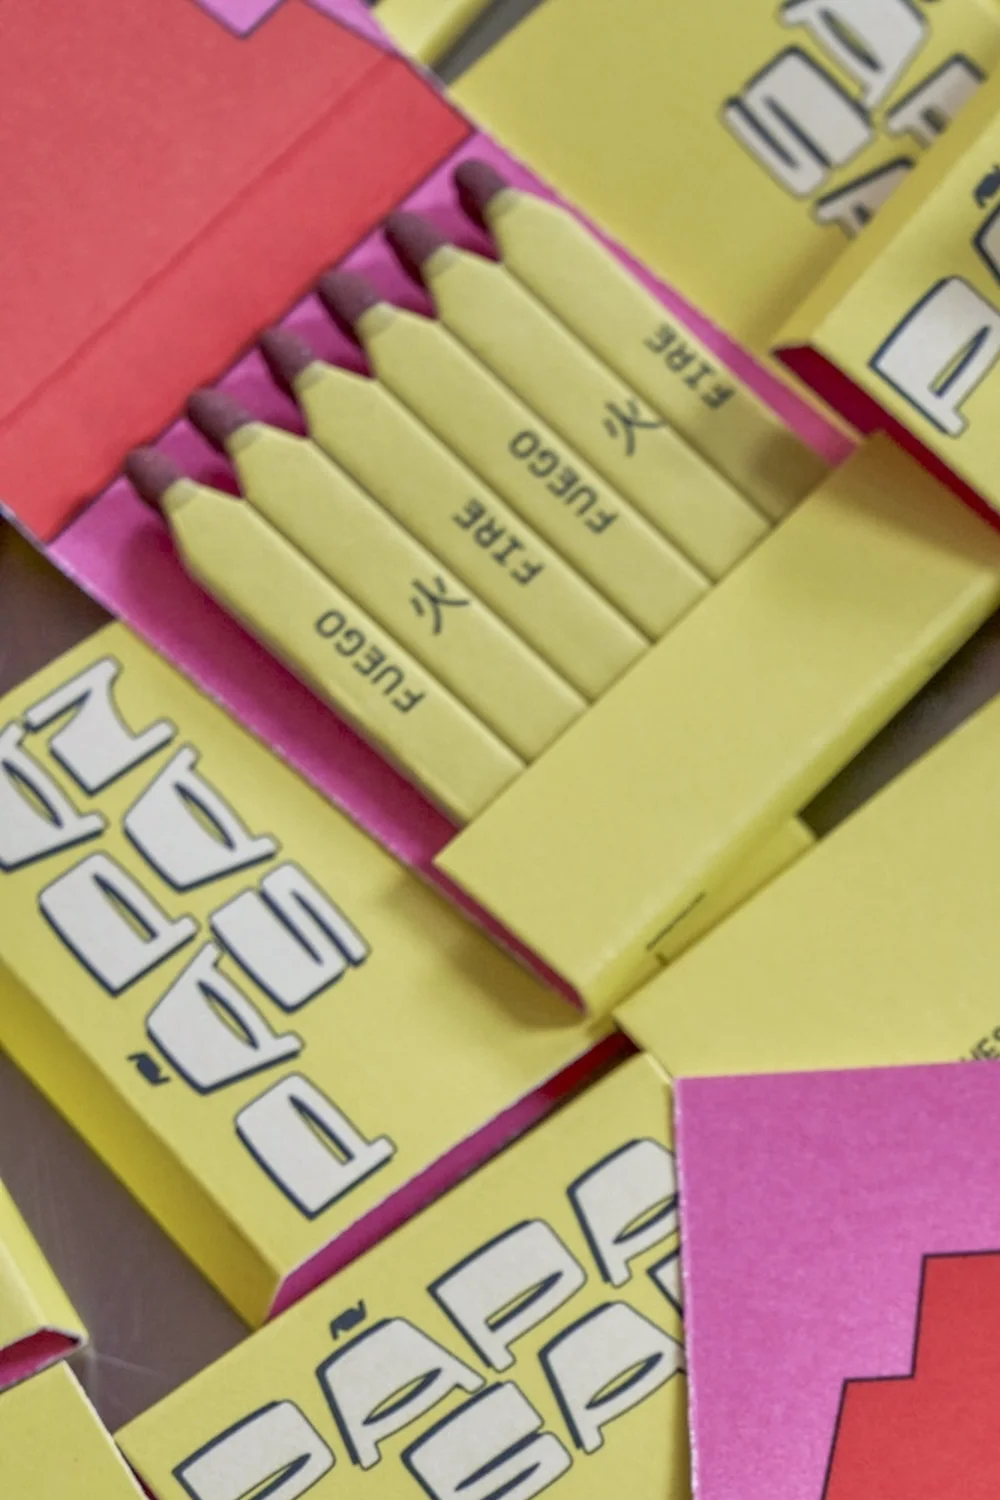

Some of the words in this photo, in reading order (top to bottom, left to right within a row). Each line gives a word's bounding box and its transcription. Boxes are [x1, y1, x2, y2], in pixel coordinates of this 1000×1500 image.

[644, 323, 739, 410] FIRE
[601, 397, 664, 457] 火
[507, 428, 622, 535] FUEGO
[451, 497, 547, 587] FIRE
[409, 575, 470, 634] 火
[314, 607, 428, 715] FUEGO
[23, 655, 371, 1014] SAN
